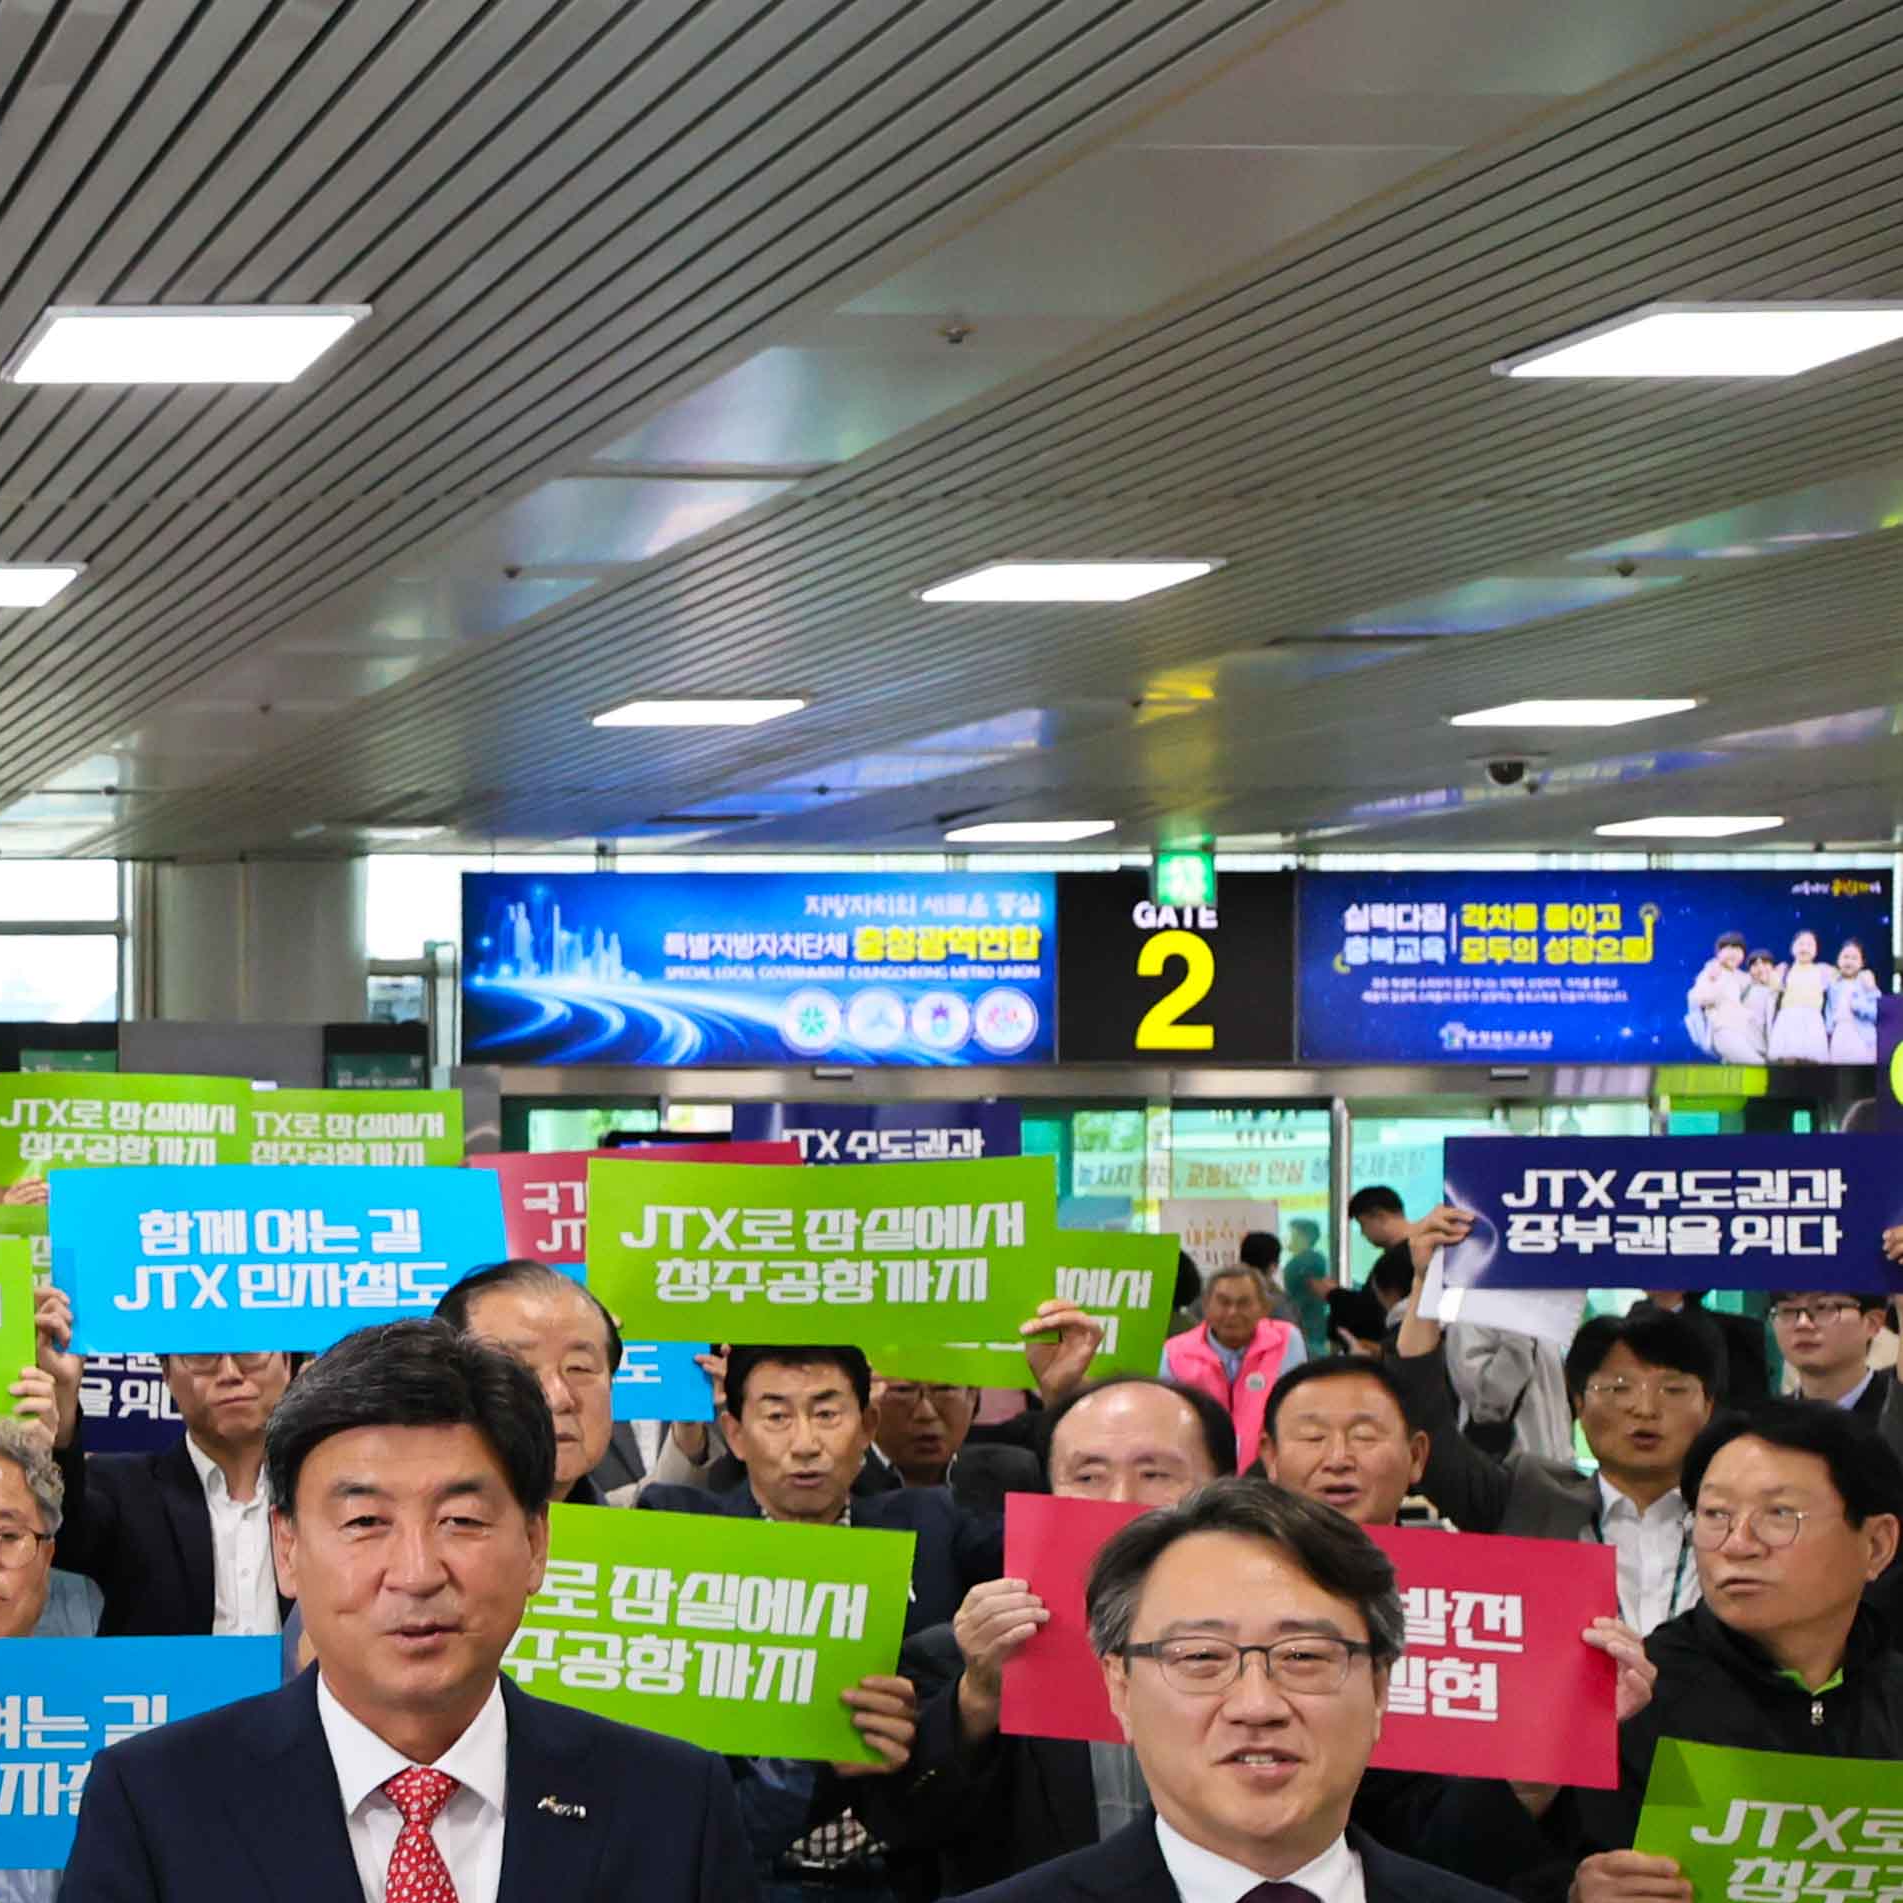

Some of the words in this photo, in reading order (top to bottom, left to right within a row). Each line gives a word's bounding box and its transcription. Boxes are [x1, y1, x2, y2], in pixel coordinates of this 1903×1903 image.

[1132, 901, 1218, 929] GATE
[1135, 929, 1215, 1049] 2
[108, 1098, 237, 1134] 잠실에서
[325, 1111, 445, 1139] 잠실에서
[845, 1128, 986, 1160] 수도권과
[1502, 1170, 1618, 1209] JTX
[1625, 1169, 1848, 1210] 수도권과
[138, 1209, 247, 1258] 함께
[255, 1209, 362, 1257] 여는
[370, 1208, 422, 1254] 길
[620, 1204, 794, 1252] JTX로
[803, 1201, 1026, 1252] 잠실에서
[1506, 1215, 1721, 1257] 중부권을
[1731, 1215, 1843, 1256] 잇다
[113, 1263, 228, 1312] JTX
[239, 1260, 450, 1310] 민자철도
[655, 1257, 987, 1304] 청주공항까지
[1055, 1266, 1153, 1310] 에서
[609, 1564, 869, 1641] 잠실에서
[1690, 1798, 1903, 1855] JTX로
